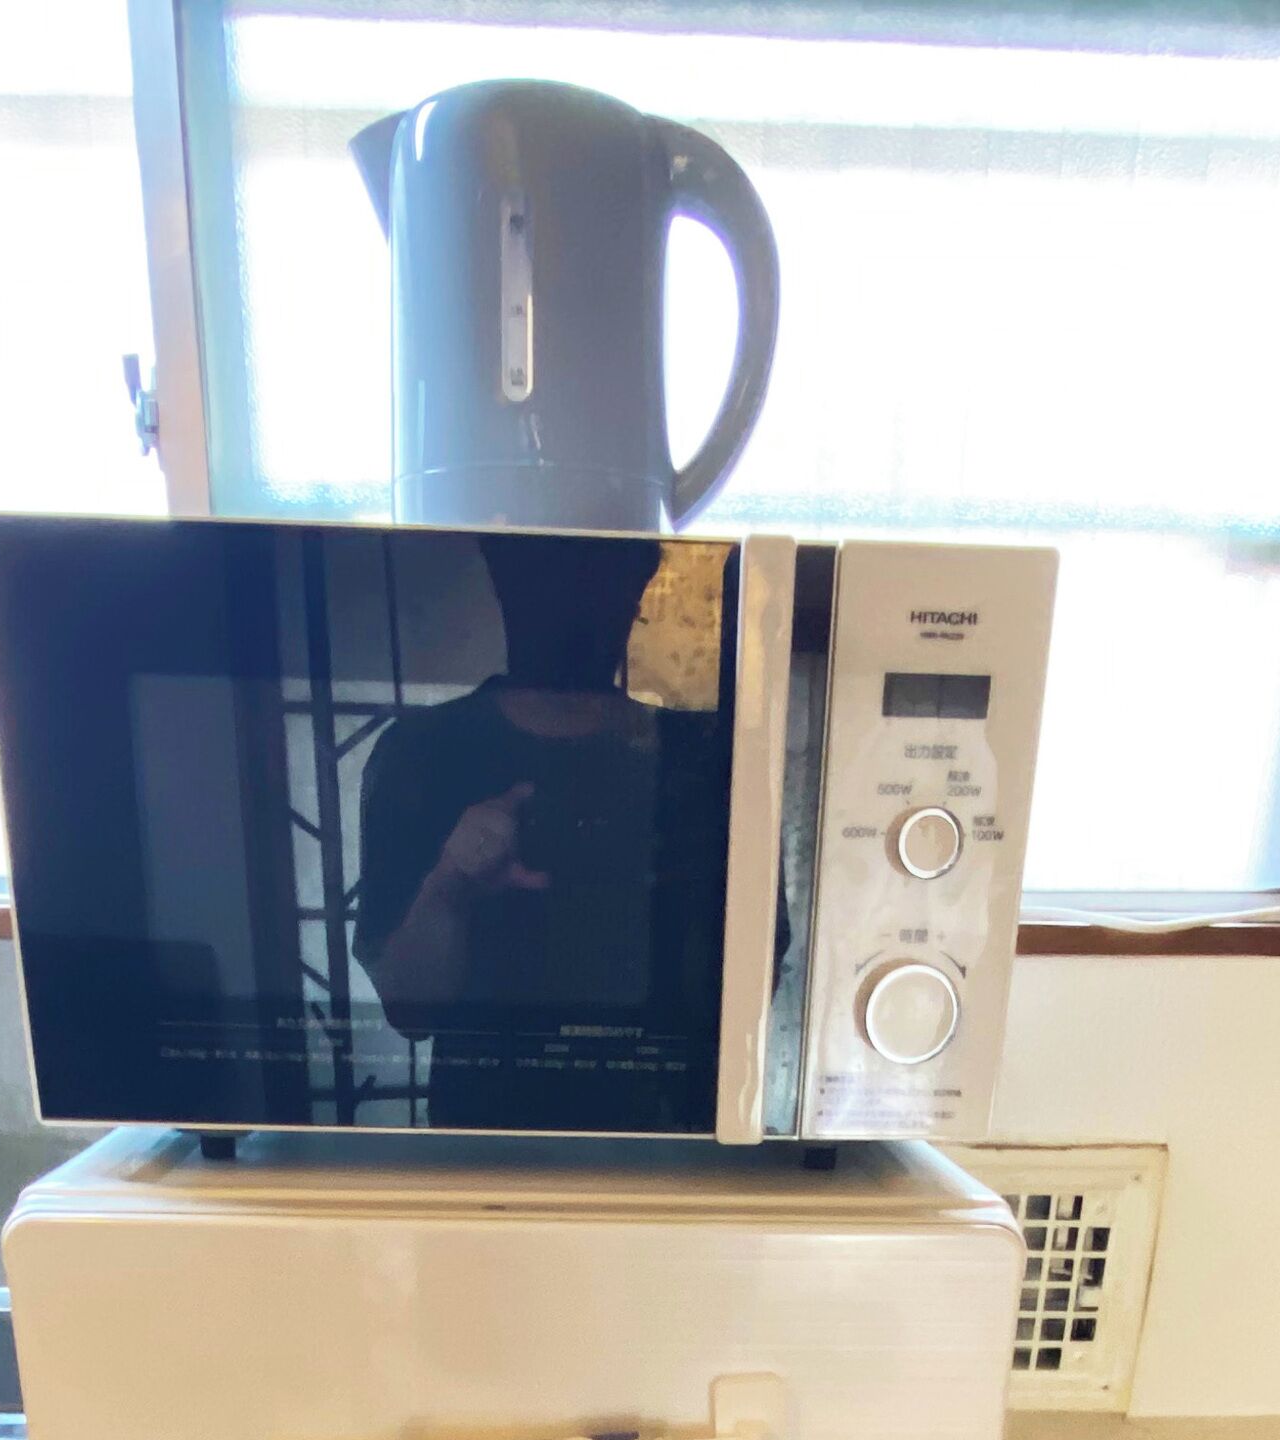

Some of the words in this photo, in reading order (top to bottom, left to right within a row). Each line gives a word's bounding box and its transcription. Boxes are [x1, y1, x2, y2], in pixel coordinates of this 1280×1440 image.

[910, 610, 978, 626] HITACHI
[877, 783, 913, 796] 500W
[946, 785, 982, 798] 200W
[841, 826, 878, 839] 600W
[972, 829, 1005, 842] 100W
